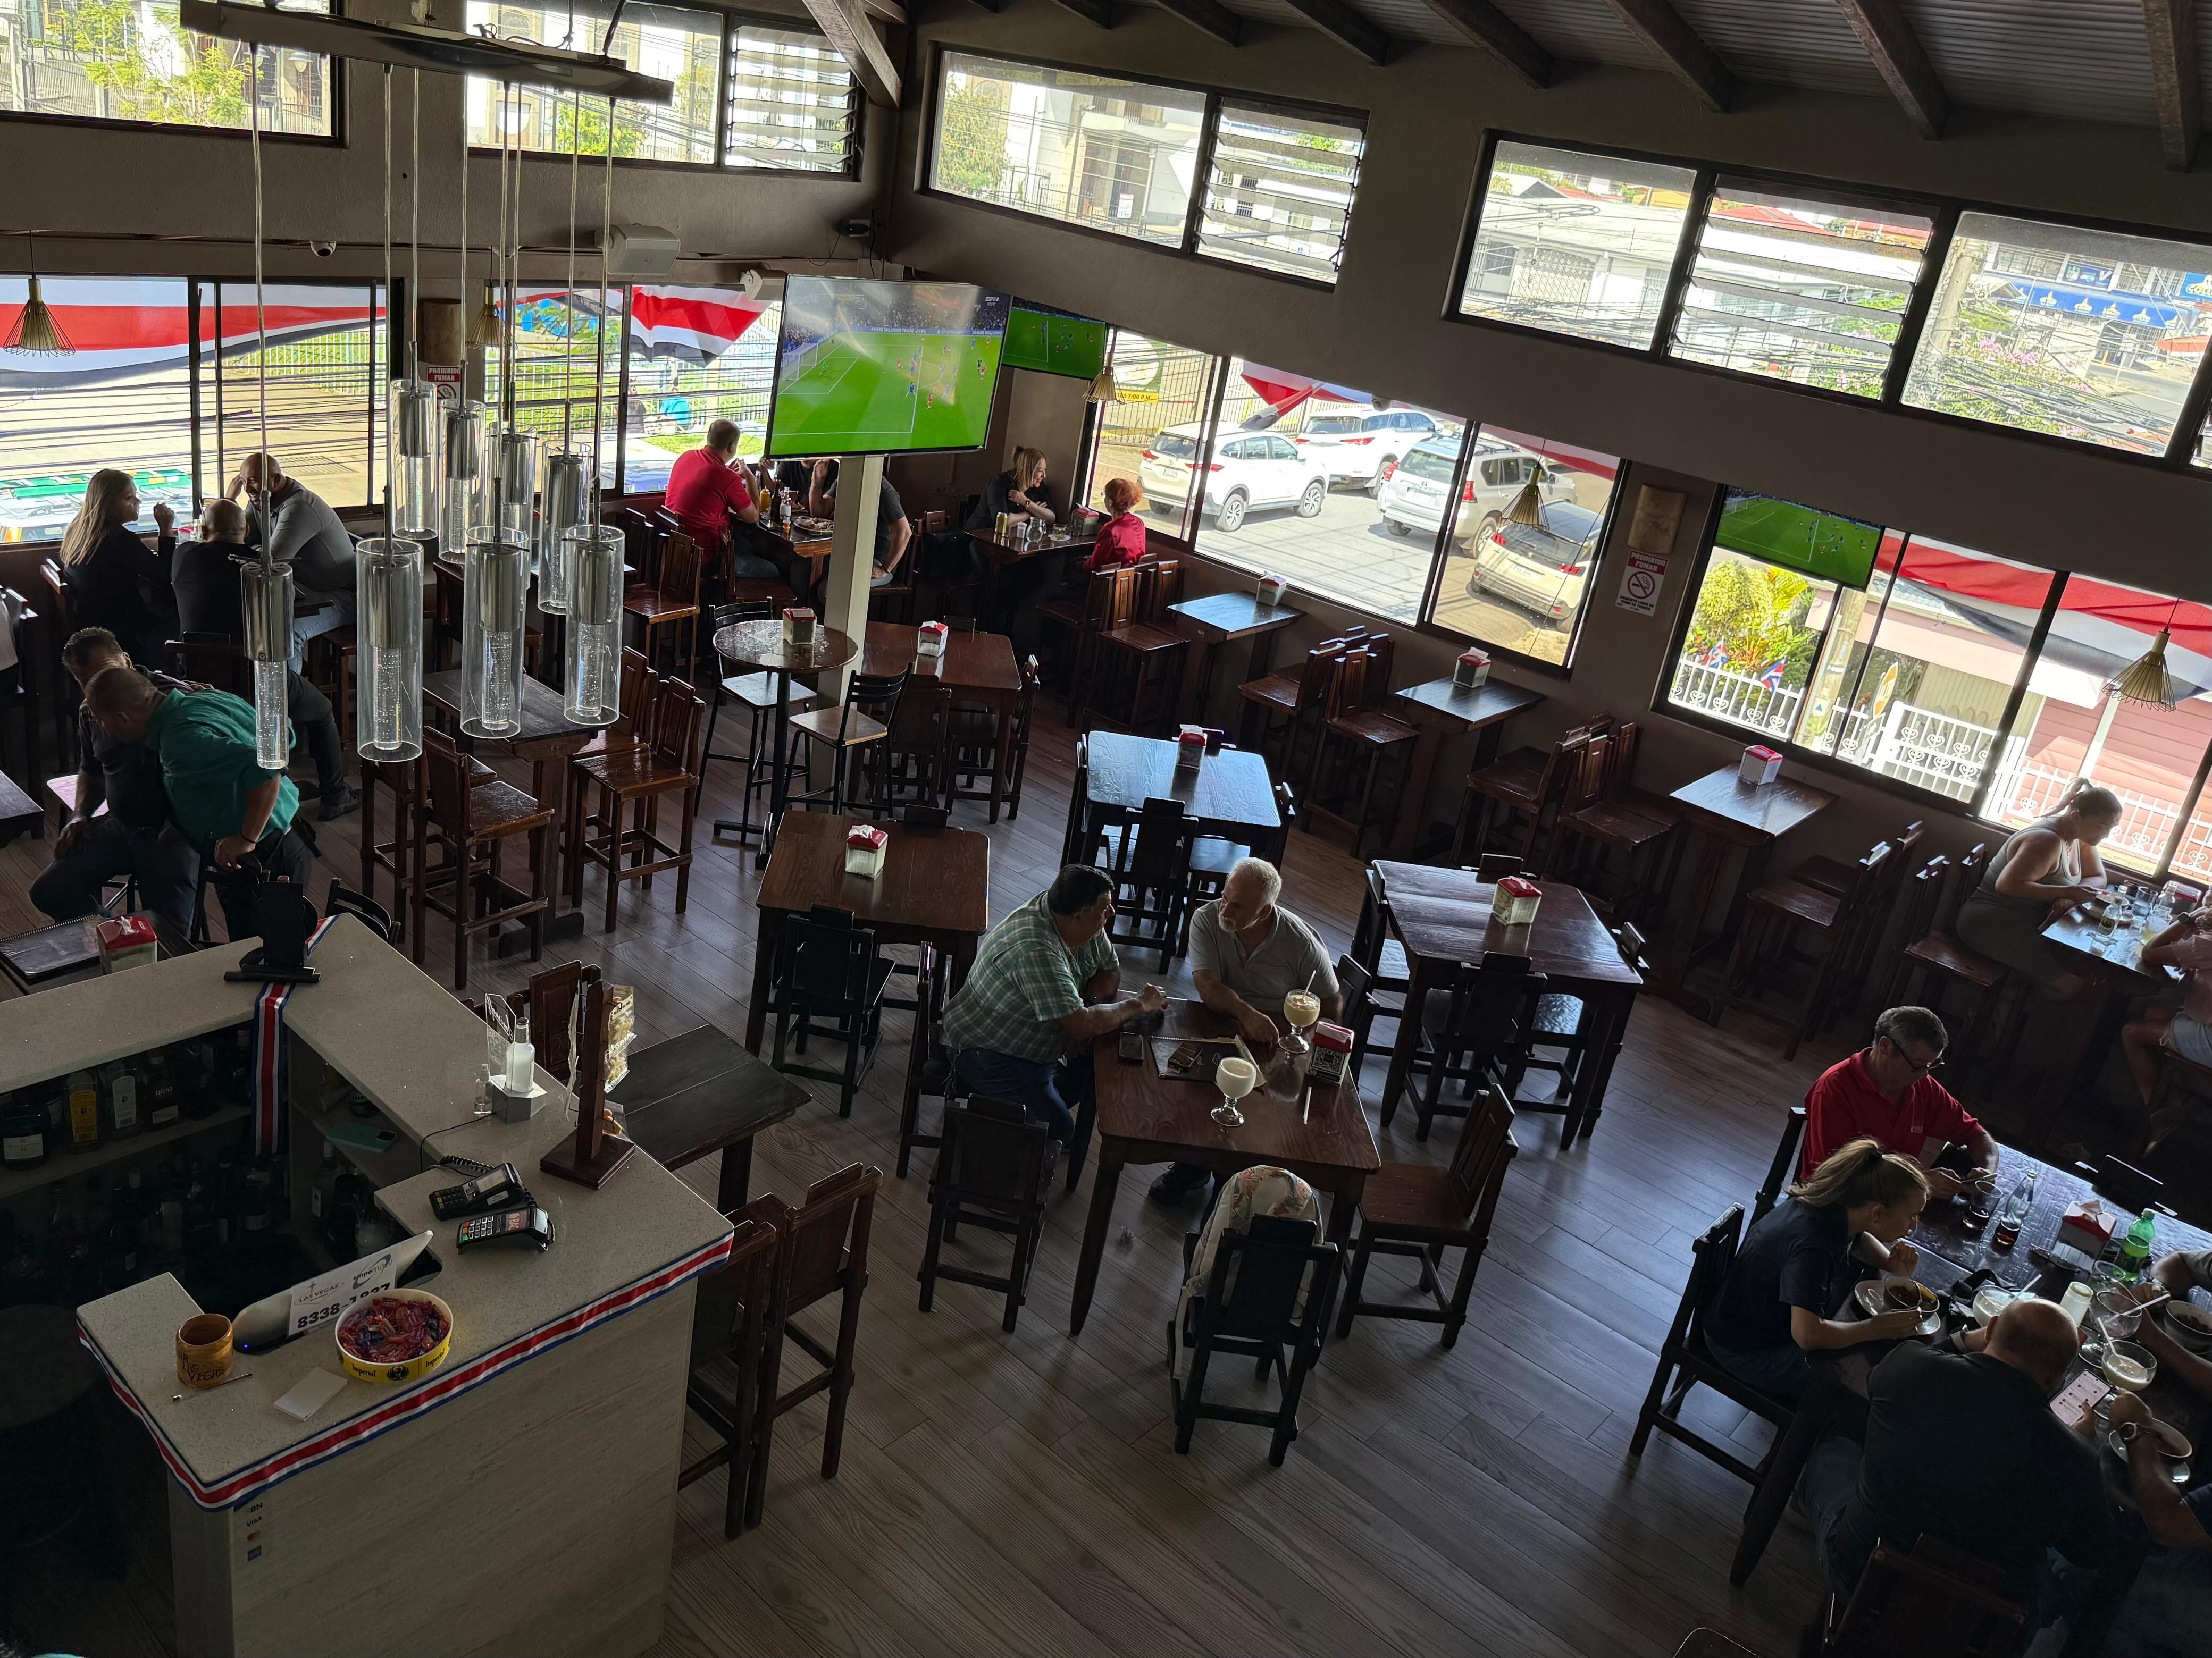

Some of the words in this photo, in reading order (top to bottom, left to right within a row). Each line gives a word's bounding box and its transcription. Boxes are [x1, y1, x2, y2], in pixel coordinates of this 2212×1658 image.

[1630, 552, 1666, 567] PROHIBIDO
[1635, 560, 1658, 572] FUMAR
[508, 1218, 520, 1231] BAC
[299, 1293, 313, 1303] LAS
[315, 1284, 339, 1297] VEGAS
[182, 1361, 199, 1373] LAS
[352, 1364, 376, 1377] Imperial
[188, 1367, 224, 1381] VEGAS
[247, 1516, 262, 1527] VISA
